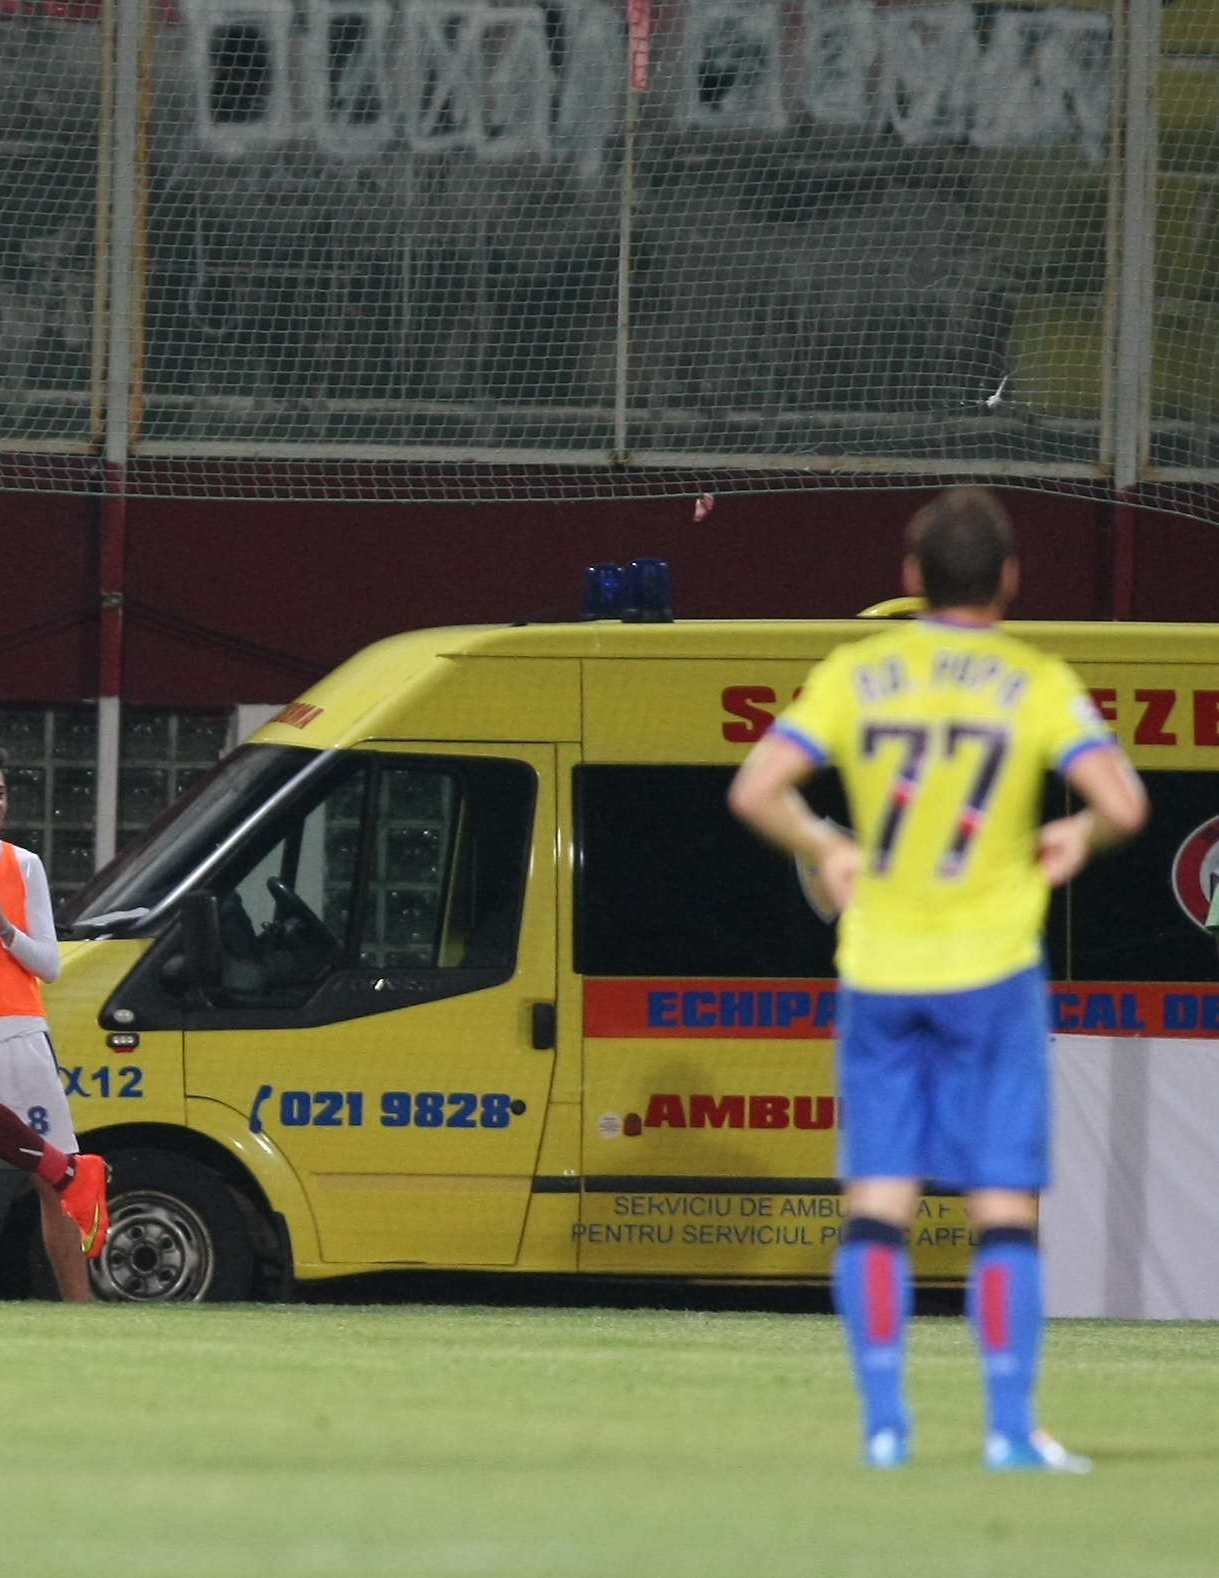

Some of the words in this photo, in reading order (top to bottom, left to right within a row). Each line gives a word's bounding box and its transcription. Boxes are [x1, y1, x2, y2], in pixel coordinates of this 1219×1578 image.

[862, 721, 1010, 880] 77
[27, 1106, 49, 1134] 8
[281, 1091, 363, 1126] 021
[380, 1092, 510, 1128] 9828
[644, 1094, 843, 1130] AMBU
[615, 1196, 732, 1217] SERVICIU
[740, 1197, 773, 1217] DE
[571, 1223, 674, 1244] PENTRU
[683, 1225, 813, 1245] SERVICIUL
